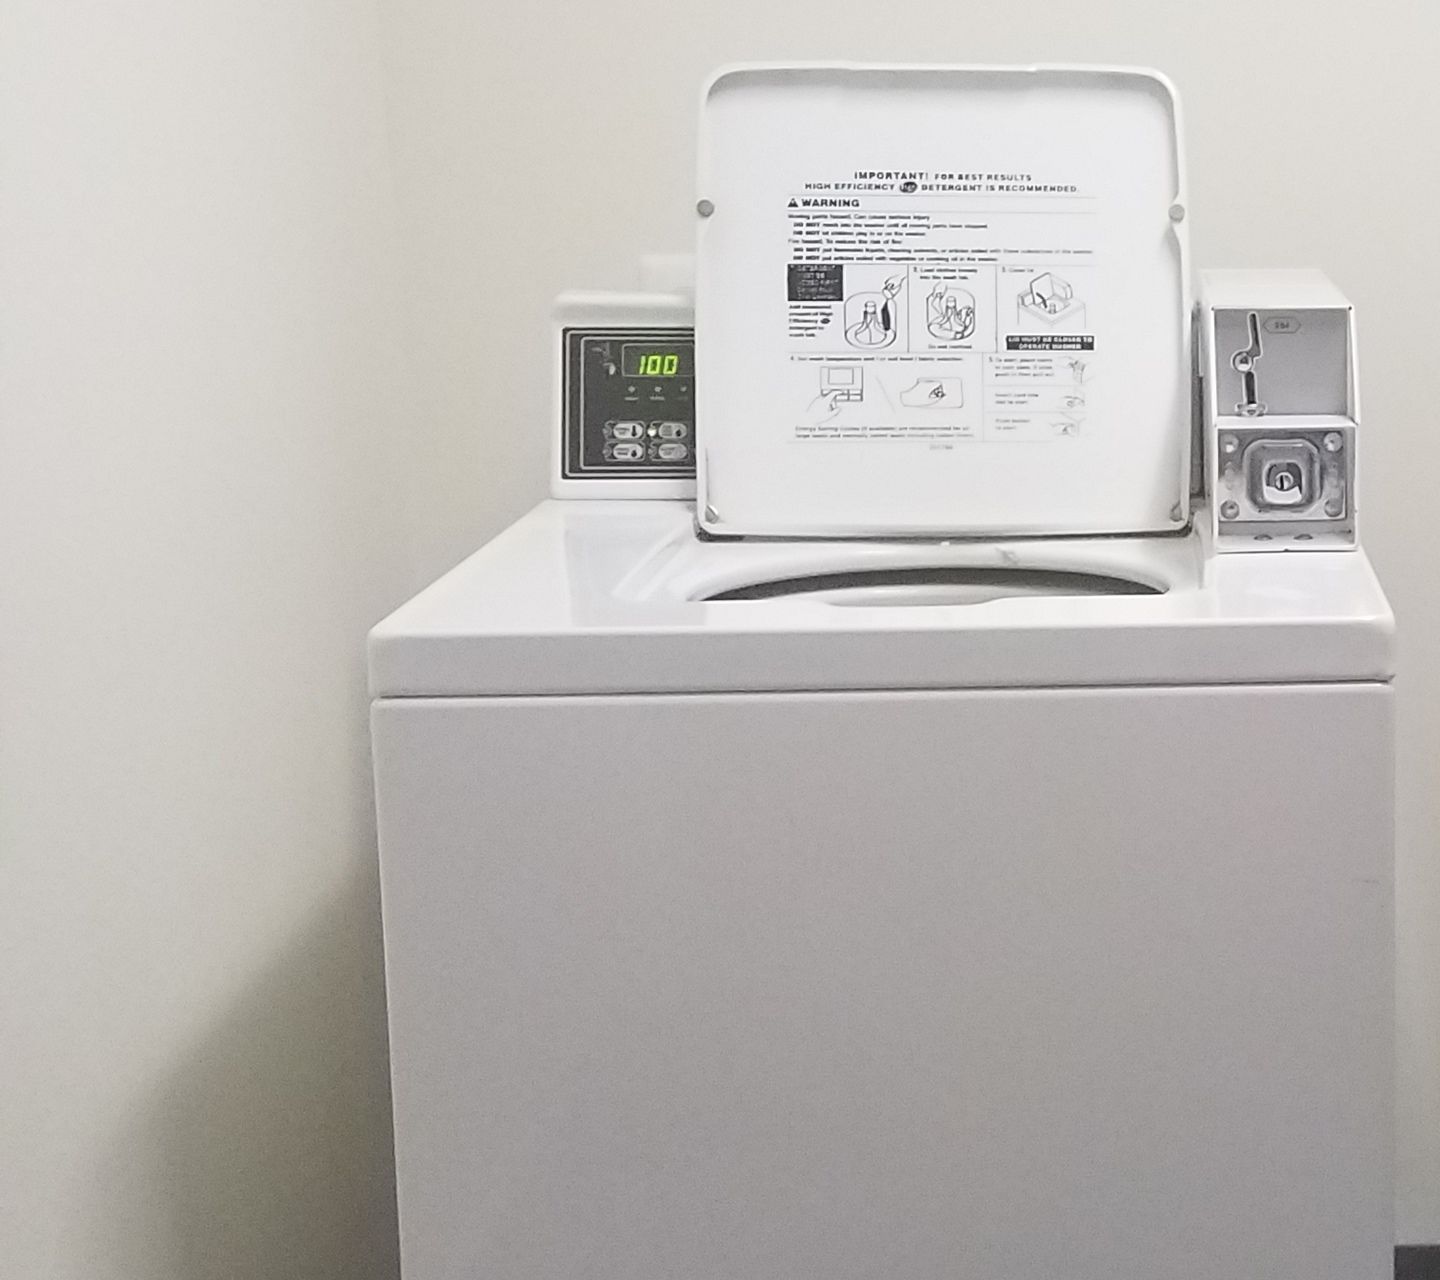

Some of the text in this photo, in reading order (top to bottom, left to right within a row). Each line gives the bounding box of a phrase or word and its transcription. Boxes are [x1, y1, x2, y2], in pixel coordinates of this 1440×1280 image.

[853, 171, 1032, 182] IMPORTANT! FOR BEST RESULTS
[804, 182, 831, 191] HIGH
[834, 182, 895, 191] EFFICIENCY
[921, 183, 983, 192] DETERGENT
[985, 184, 996, 192] IS
[801, 198, 860, 208] WARNING
[638, 354, 679, 376] 100
